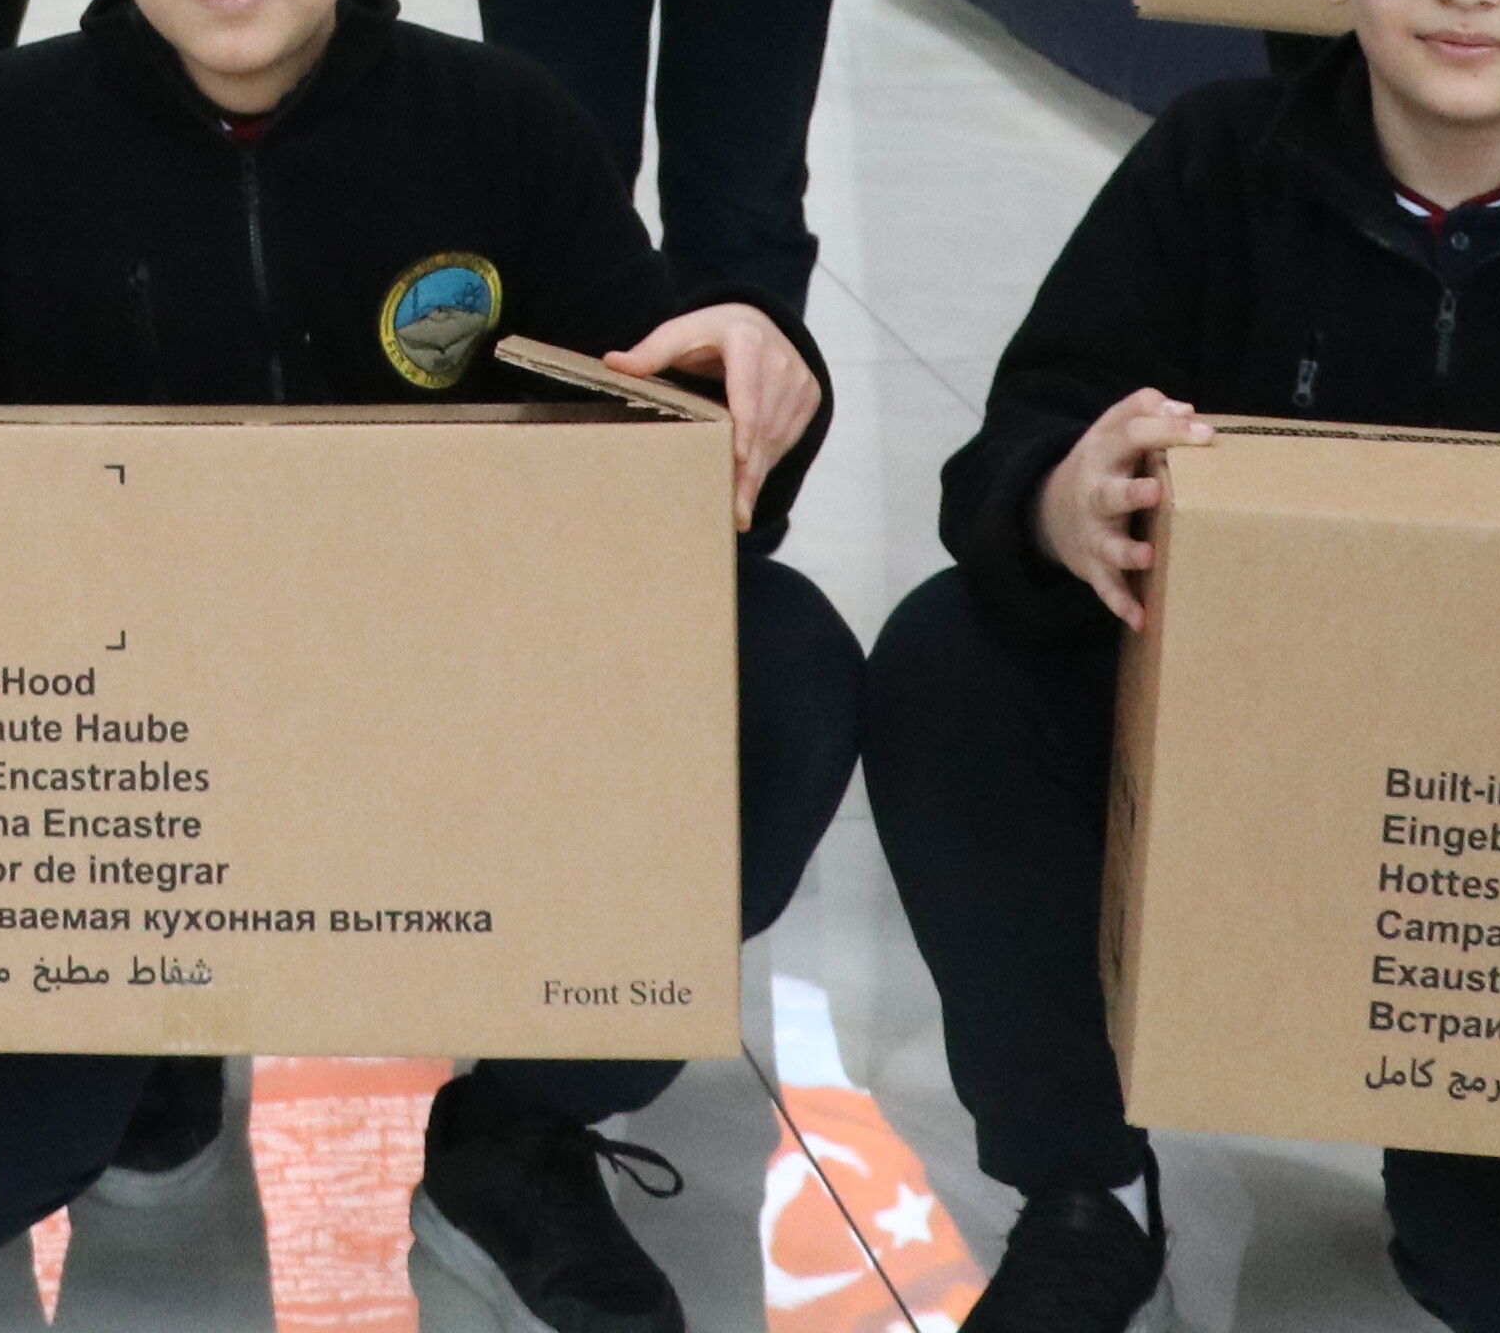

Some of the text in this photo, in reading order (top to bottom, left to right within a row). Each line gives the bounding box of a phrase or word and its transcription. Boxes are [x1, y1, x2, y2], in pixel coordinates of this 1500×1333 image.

[1, 666, 95, 697] Hood
[75, 713, 189, 744] Haube
[43, 808, 202, 839] Encastre
[33, 854, 76, 884] de
[89, 854, 230, 893] integrar
[1378, 862, 1500, 901] Hottes
[144, 909, 316, 939] кухонная
[329, 910, 493, 933] вытяжка
[32, 954, 110, 994] مطبخ
[544, 979, 692, 1006] Front Side
[1364, 1055, 1436, 1091] كامل
